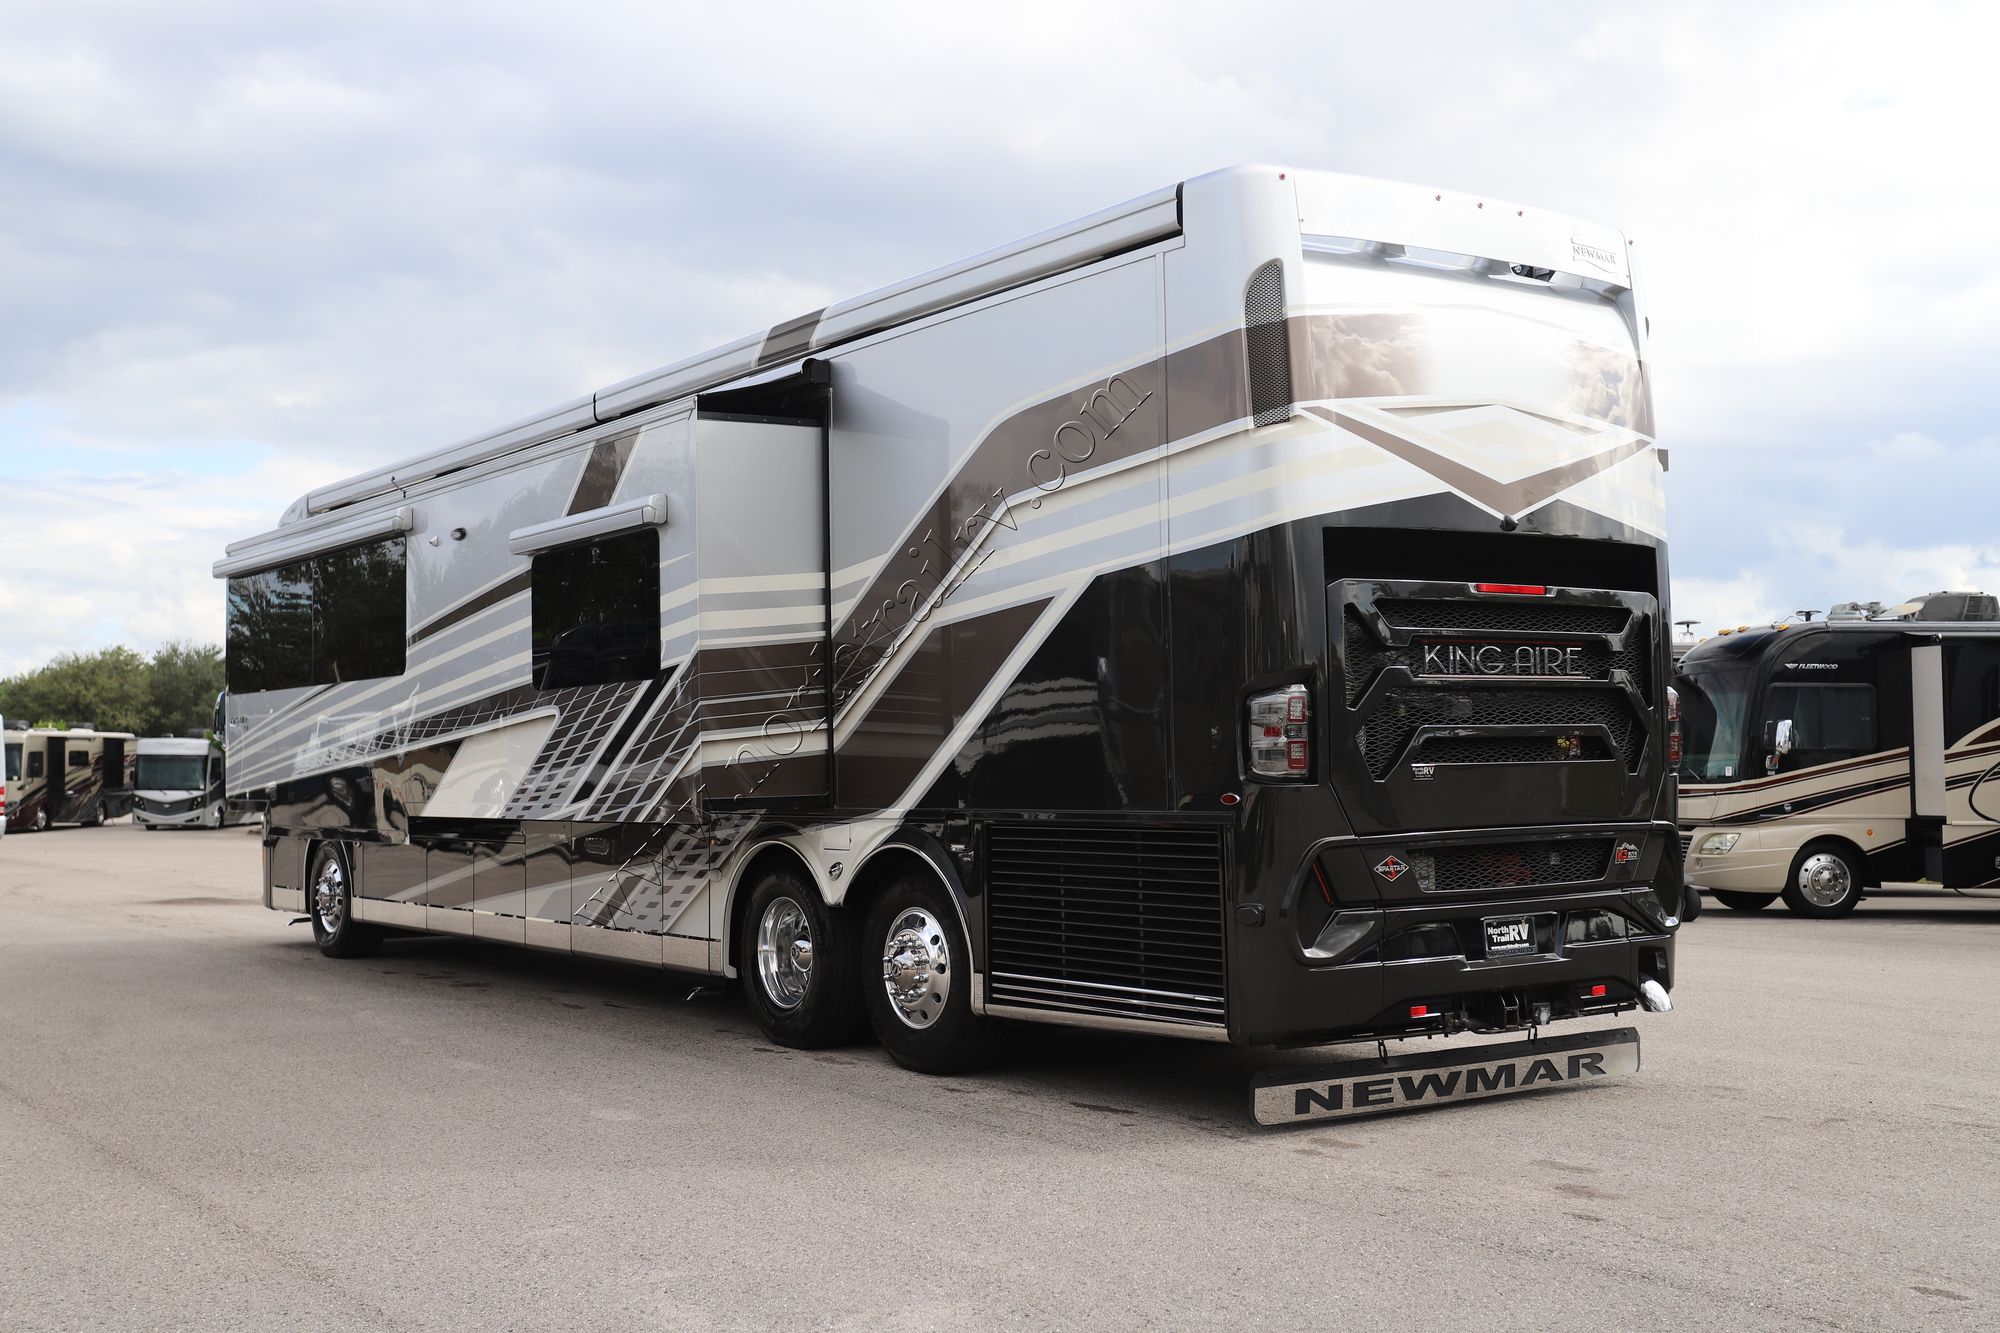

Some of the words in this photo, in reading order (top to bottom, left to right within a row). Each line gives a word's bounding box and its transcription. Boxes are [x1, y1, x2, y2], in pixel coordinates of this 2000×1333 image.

[1573, 245, 1617, 265] NEWMAR
[1424, 645, 1504, 674] KING
[1512, 646, 1583, 675] AIRE
[1423, 767, 1435, 775] RV
[1377, 864, 1406, 872] SPARTAN
[1487, 925, 1509, 935] North
[1508, 923, 1530, 942] RV
[1492, 934, 1510, 943] Trail
[1294, 1052, 1607, 1116] NEWMAR
